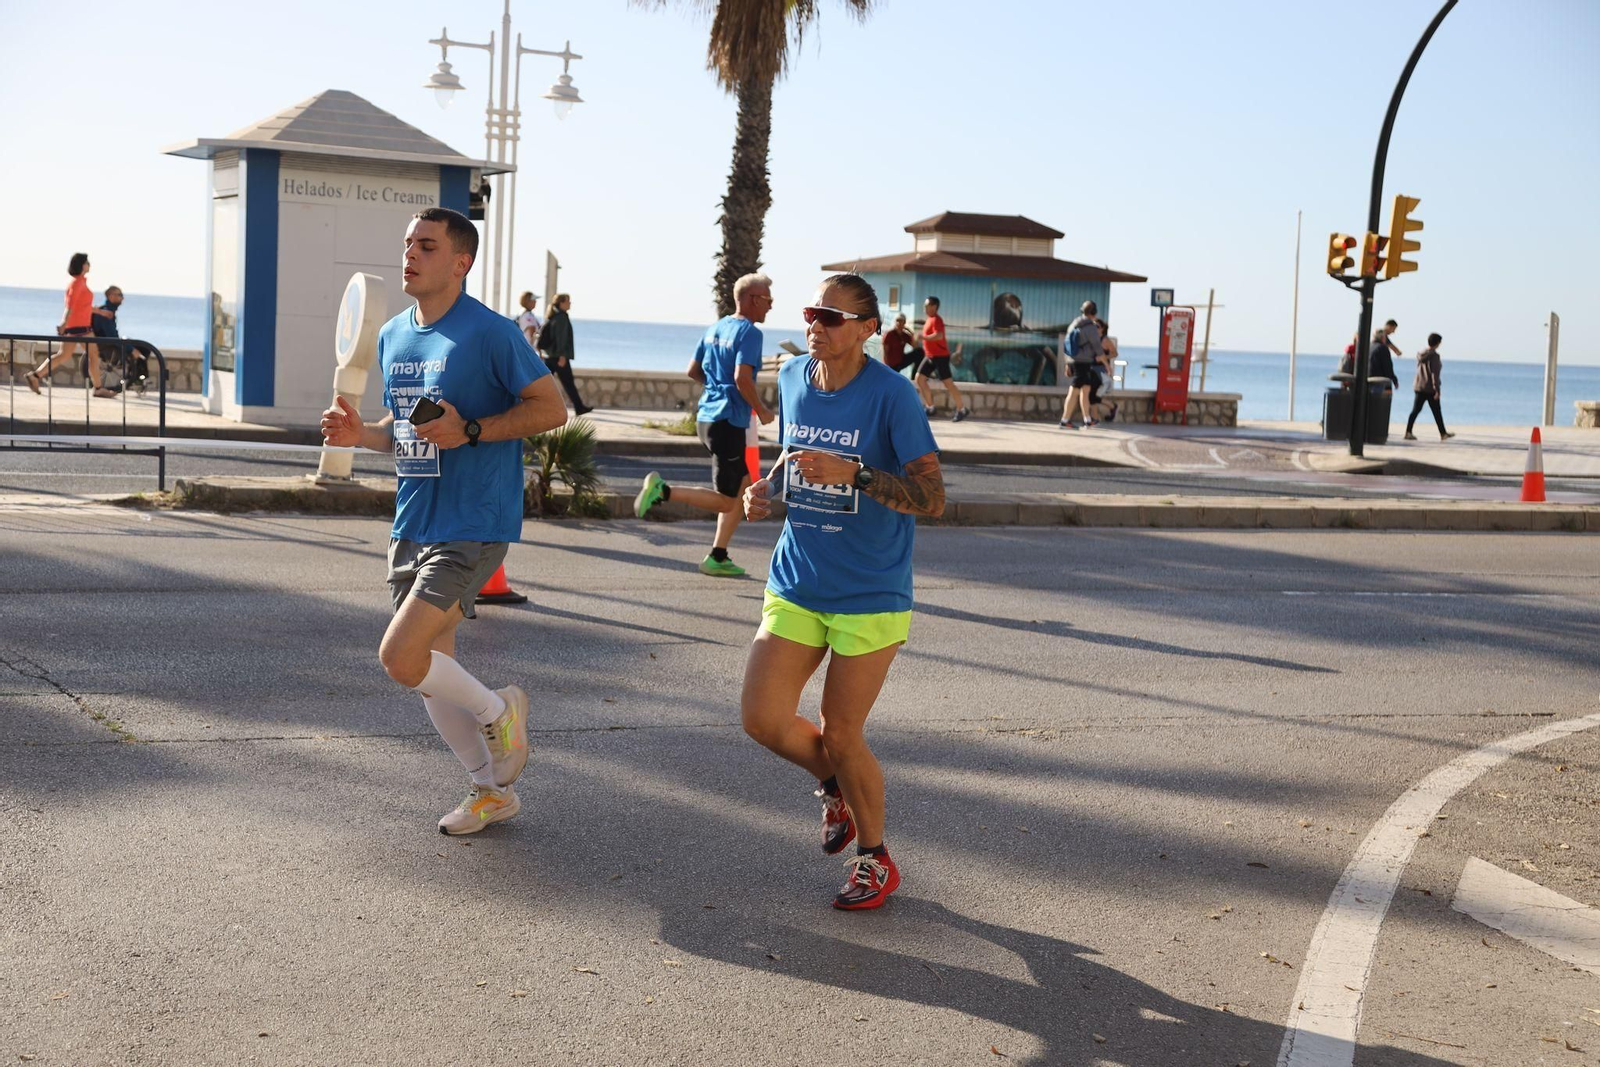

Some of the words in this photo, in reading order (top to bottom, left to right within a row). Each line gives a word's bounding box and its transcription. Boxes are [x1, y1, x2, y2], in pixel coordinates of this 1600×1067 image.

[284, 178, 342, 198] Helados
[346, 184, 353, 199] /
[357, 185, 378, 201] Ice
[382, 186, 435, 205] Creams
[389, 355, 448, 379] mayoral
[785, 422, 860, 448] mayoral
[396, 441, 430, 457] 2017
